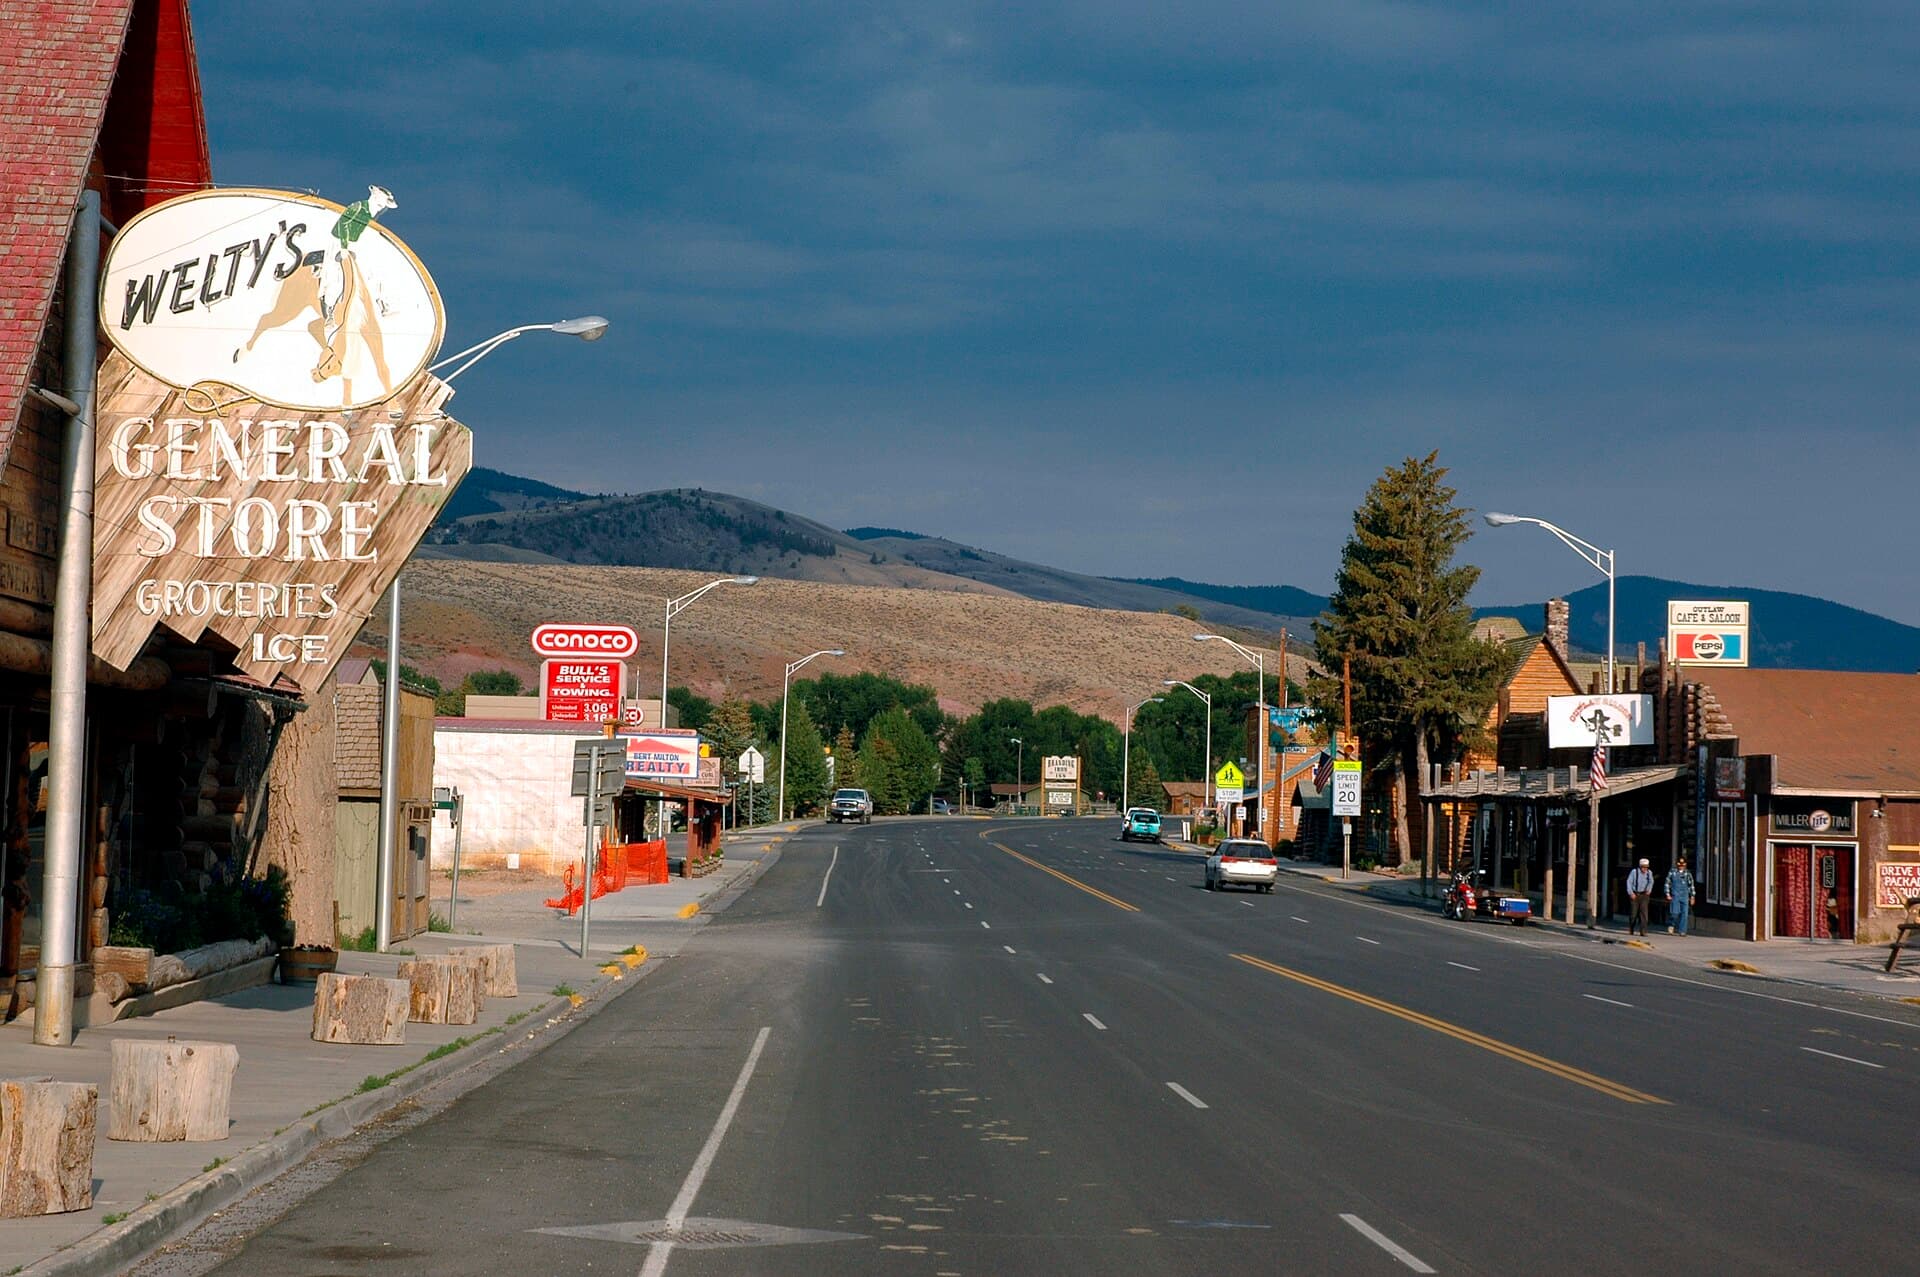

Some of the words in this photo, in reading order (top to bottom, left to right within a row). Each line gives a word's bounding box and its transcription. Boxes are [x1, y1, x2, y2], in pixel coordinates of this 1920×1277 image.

[120, 219, 307, 331] WELTY'S
[108, 416, 448, 487] GENERAL
[136, 494, 379, 564] STORE
[135, 578, 339, 619] GROCERIES
[1676, 612, 1699, 623] CAFE
[1709, 613, 1741, 623] SALOON
[252, 632, 330, 664] ICE
[1694, 642, 1723, 650] PEPSI
[559, 665, 609, 676] BULL'S
[556, 675, 611, 684] SERVICE
[551, 688, 610, 697] TOWING
[626, 761, 685, 773] REALTY
[1338, 791, 1356, 803] 20
[1775, 814, 1809, 826] MILLER
[1881, 866, 1913, 877] DRIVE
